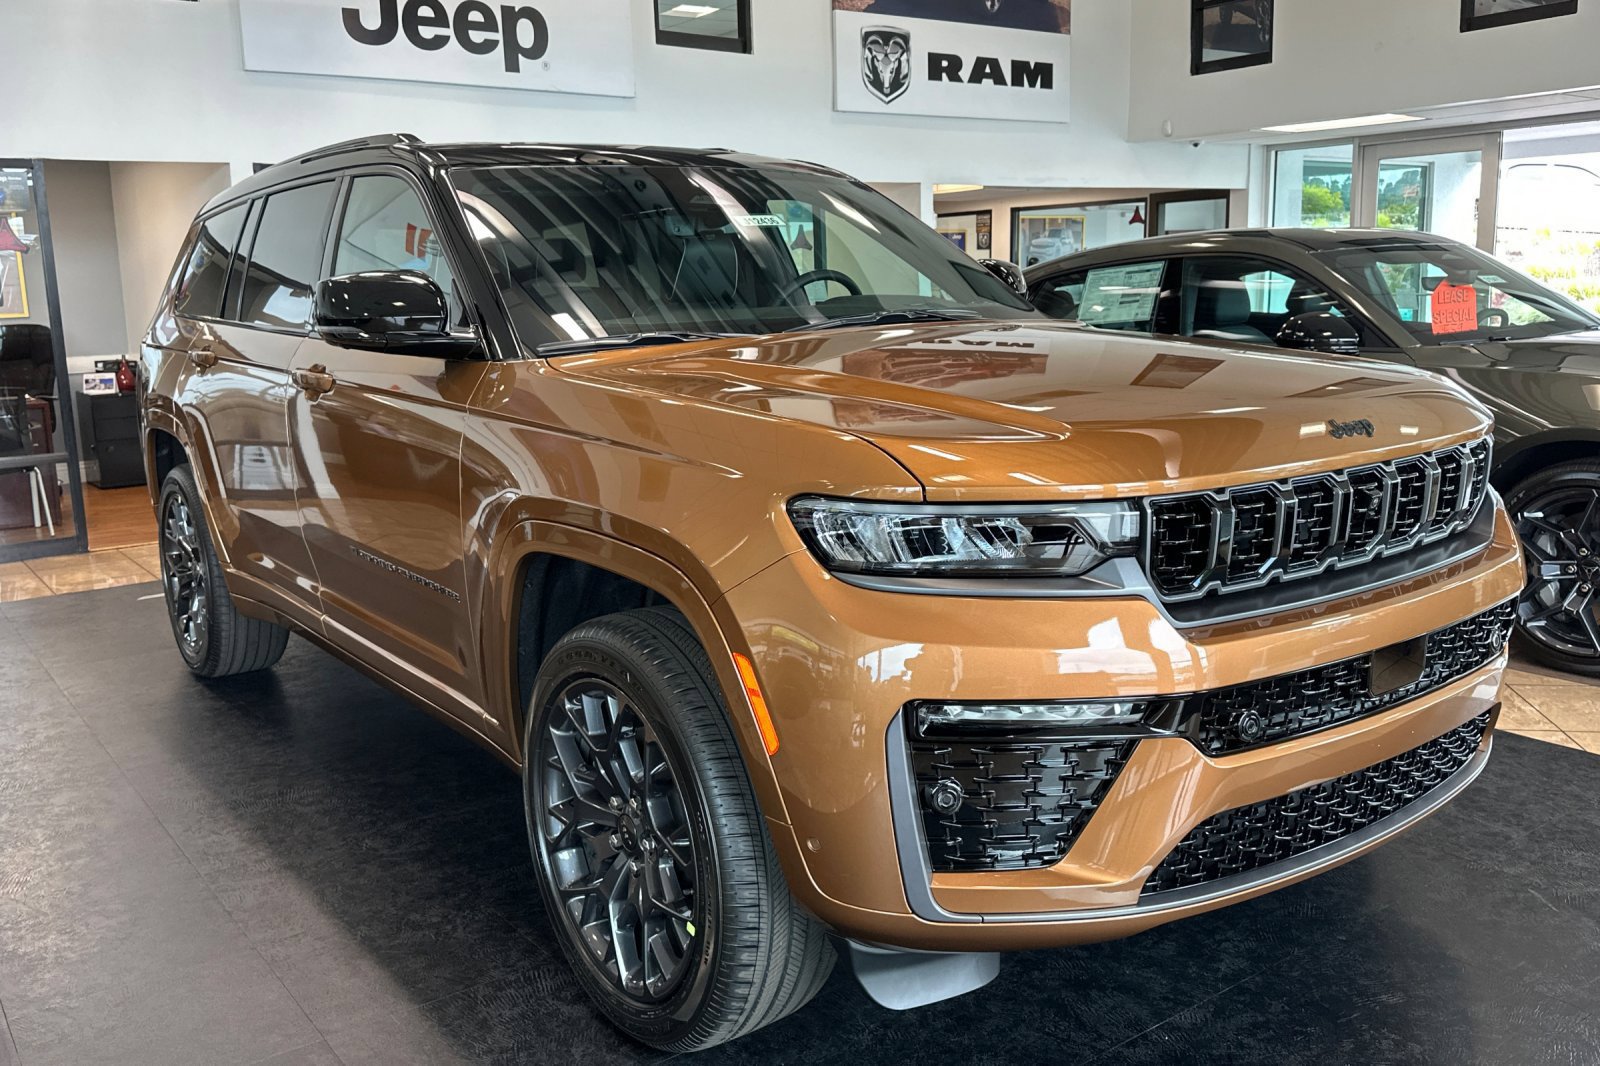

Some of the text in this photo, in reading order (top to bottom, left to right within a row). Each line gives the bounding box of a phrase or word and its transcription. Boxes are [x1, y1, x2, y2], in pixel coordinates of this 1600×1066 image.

[341, 0, 549, 73] Jeep
[927, 51, 1054, 90] RAM
[1437, 288, 1469, 304] LEASE
[1432, 308, 1475, 324] SPECIAL
[1327, 418, 1375, 439] Jeep
